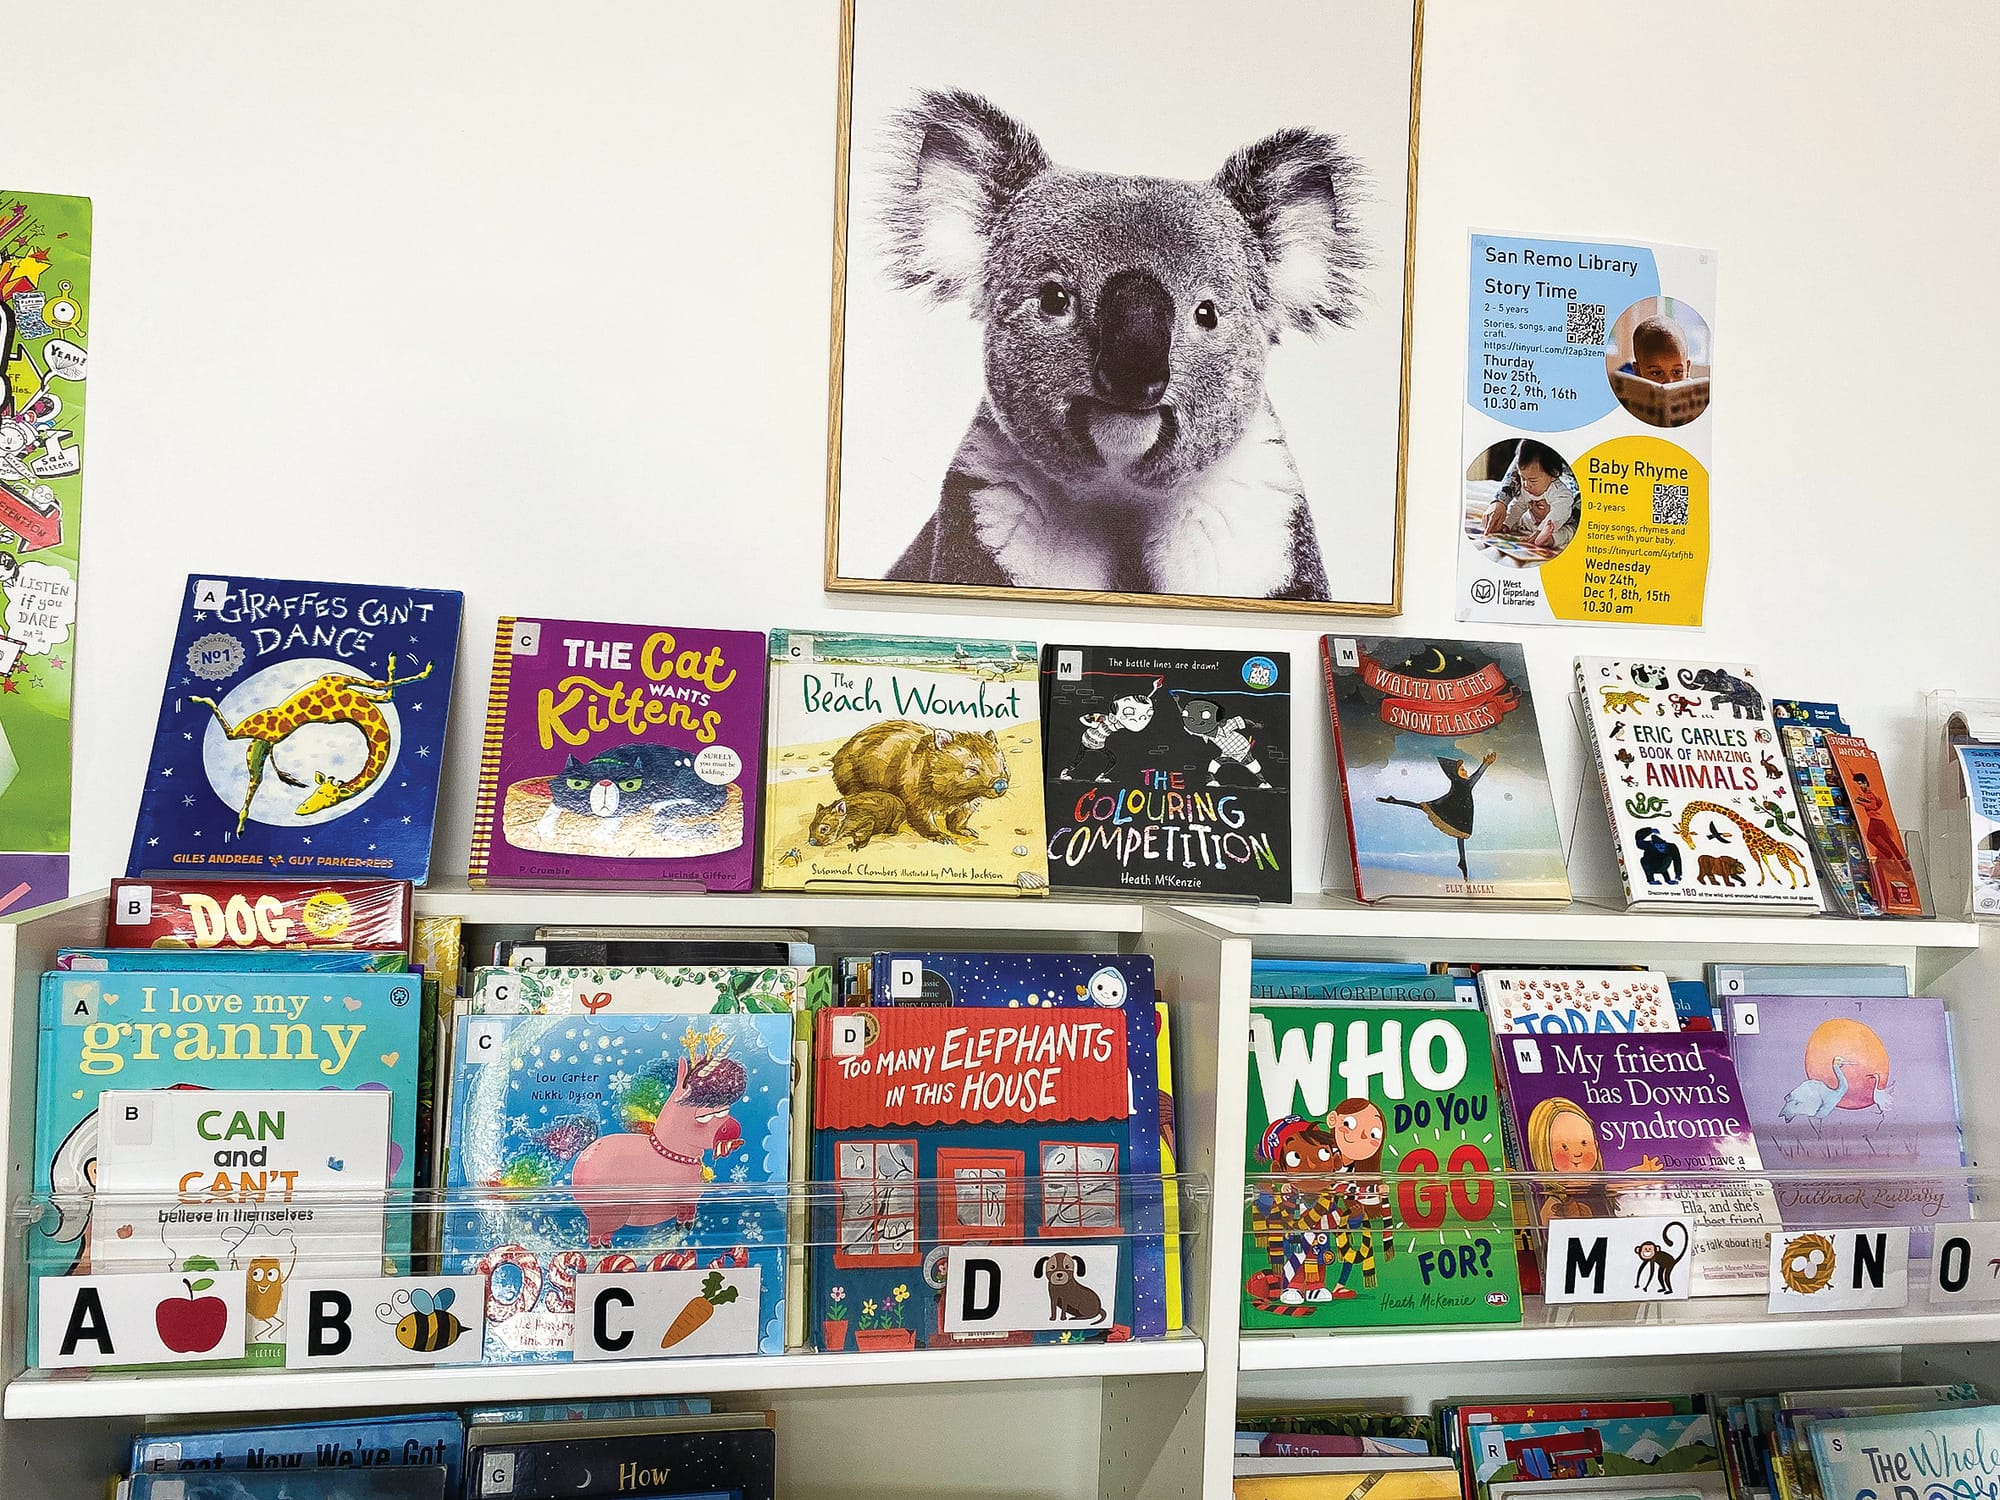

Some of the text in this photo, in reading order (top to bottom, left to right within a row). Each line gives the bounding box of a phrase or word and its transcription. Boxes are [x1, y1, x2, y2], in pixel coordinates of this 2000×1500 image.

[1485, 247, 1638, 277] San Remo Library
[1485, 279, 1577, 299] Story Time
[1499, 304, 1504, 312] 5
[1506, 306, 1528, 315] years
[1484, 319, 1562, 332] Stories, songs, and
[1483, 355, 1534, 371] Thurday
[1484, 369, 1541, 384] Nov 25th,
[1483, 383, 1577, 400] Dec 2, 9th, 16th
[1483, 398, 1538, 411] 10.30 am
[1589, 458, 1688, 481] Baby Rhyme
[1588, 478, 1629, 495] Time
[1588, 502, 1625, 513] 0-2 years
[1588, 521, 1685, 536] Enjoy songs, rhymes and
[1587, 532, 1675, 545] stories with your baby.
[1586, 559, 1650, 574] Wednesday
[20, 576, 69, 596] LISTEN
[1503, 580, 1521, 588] West
[1584, 573, 1637, 588] Nov 24th,
[203, 591, 215, 603] A
[1503, 588, 1539, 598] Gippsland
[1583, 587, 1670, 602] Dec 1, 8th, 15th
[21, 594, 62, 610] if you
[217, 588, 434, 627] GIRAFFES CAN'T
[1503, 598, 1535, 606] Libraries
[1583, 602, 1633, 614] 10.30 am
[18, 612, 59, 628] DARE
[251, 625, 374, 656] DANCE
[521, 636, 532, 646] C
[791, 647, 800, 657] C
[1343, 650, 1353, 660] M
[563, 632, 736, 692] THE Cat
[1060, 663, 1071, 673] M
[1108, 658, 1123, 667] The
[1126, 659, 1150, 668] battle
[1154, 660, 1172, 669] lines
[1191, 661, 1219, 670] drawn!
[1601, 668, 1610, 676] C
[831, 672, 854, 690] The
[1375, 669, 1493, 701] WALTZ OF THE
[650, 684, 710, 706] WANTS
[803, 673, 1020, 719] Beach Wombat
[537, 676, 722, 750] Kittens
[1633, 725, 1748, 747] ERIC CARLE'S
[1639, 746, 1752, 763] BOOK OF AMAZING
[1140, 769, 1185, 790] THE
[1646, 762, 1759, 791] ANIMALS
[1074, 788, 1245, 829] COLOURING
[1048, 824, 1279, 871] COMPETITION
[173, 854, 313, 865] GILES ANDREAE GUY
[1121, 873, 1151, 885] Heath
[1682, 888, 1697, 896] 180
[128, 901, 141, 915] B
[181, 893, 294, 947] DOG
[902, 971, 913, 985] D
[1501, 980, 1511, 990] M
[496, 986, 508, 1000] C
[1322, 987, 1436, 1001] MORPURGO
[74, 1000, 89, 1016] A
[141, 988, 309, 1020] I love my
[479, 1034, 492, 1049] C
[844, 1029, 857, 1043] D
[79, 1022, 366, 1075] granny
[876, 1046, 936, 1076] MANY
[1521, 1052, 1531, 1062] M
[1551, 1042, 1707, 1082] My friend
[536, 1071, 599, 1083] Lou Carter
[1254, 1017, 1468, 1123] WHO
[531, 1089, 602, 1102] Nikki Dyson
[886, 1067, 1062, 1113] IN THIS HOUSE
[1583, 1074, 1730, 1106] has Down's
[125, 1106, 138, 1120] B
[1394, 1093, 1487, 1134] DO YOU
[196, 1110, 285, 1141] CAN
[1600, 1111, 1742, 1146] syndrome
[214, 1146, 267, 1167] and
[1663, 1154, 1745, 1170] Do you have a
[177, 1171, 299, 1205] CAN'T
[1398, 1144, 1495, 1229] GO
[1681, 1200, 1730, 1215] Ella, and
[1872, 1188, 1950, 1217] Lullaby
[158, 1207, 313, 1224] believe in themselves
[1707, 1239, 1750, 1250] talk about
[1418, 1238, 1493, 1286] FOR?
[1564, 1237, 1608, 1295] M
[1852, 1233, 1887, 1289] N
[961, 1259, 1001, 1321] D
[1380, 1294, 1415, 1310] Heath
[1487, 1294, 1507, 1303] AFL
[59, 1287, 114, 1356] A
[308, 1290, 353, 1357] B
[593, 1287, 635, 1352] C
[256, 1349, 280, 1358] LITTLE
[316, 1439, 391, 1467] We've
[1488, 1444, 1500, 1458] R
[1832, 1439, 1842, 1452] S
[1908, 1428, 2000, 1478] Whole
[153, 1458, 166, 1471] E
[492, 1468, 505, 1483] G
[618, 1461, 671, 1491] How
